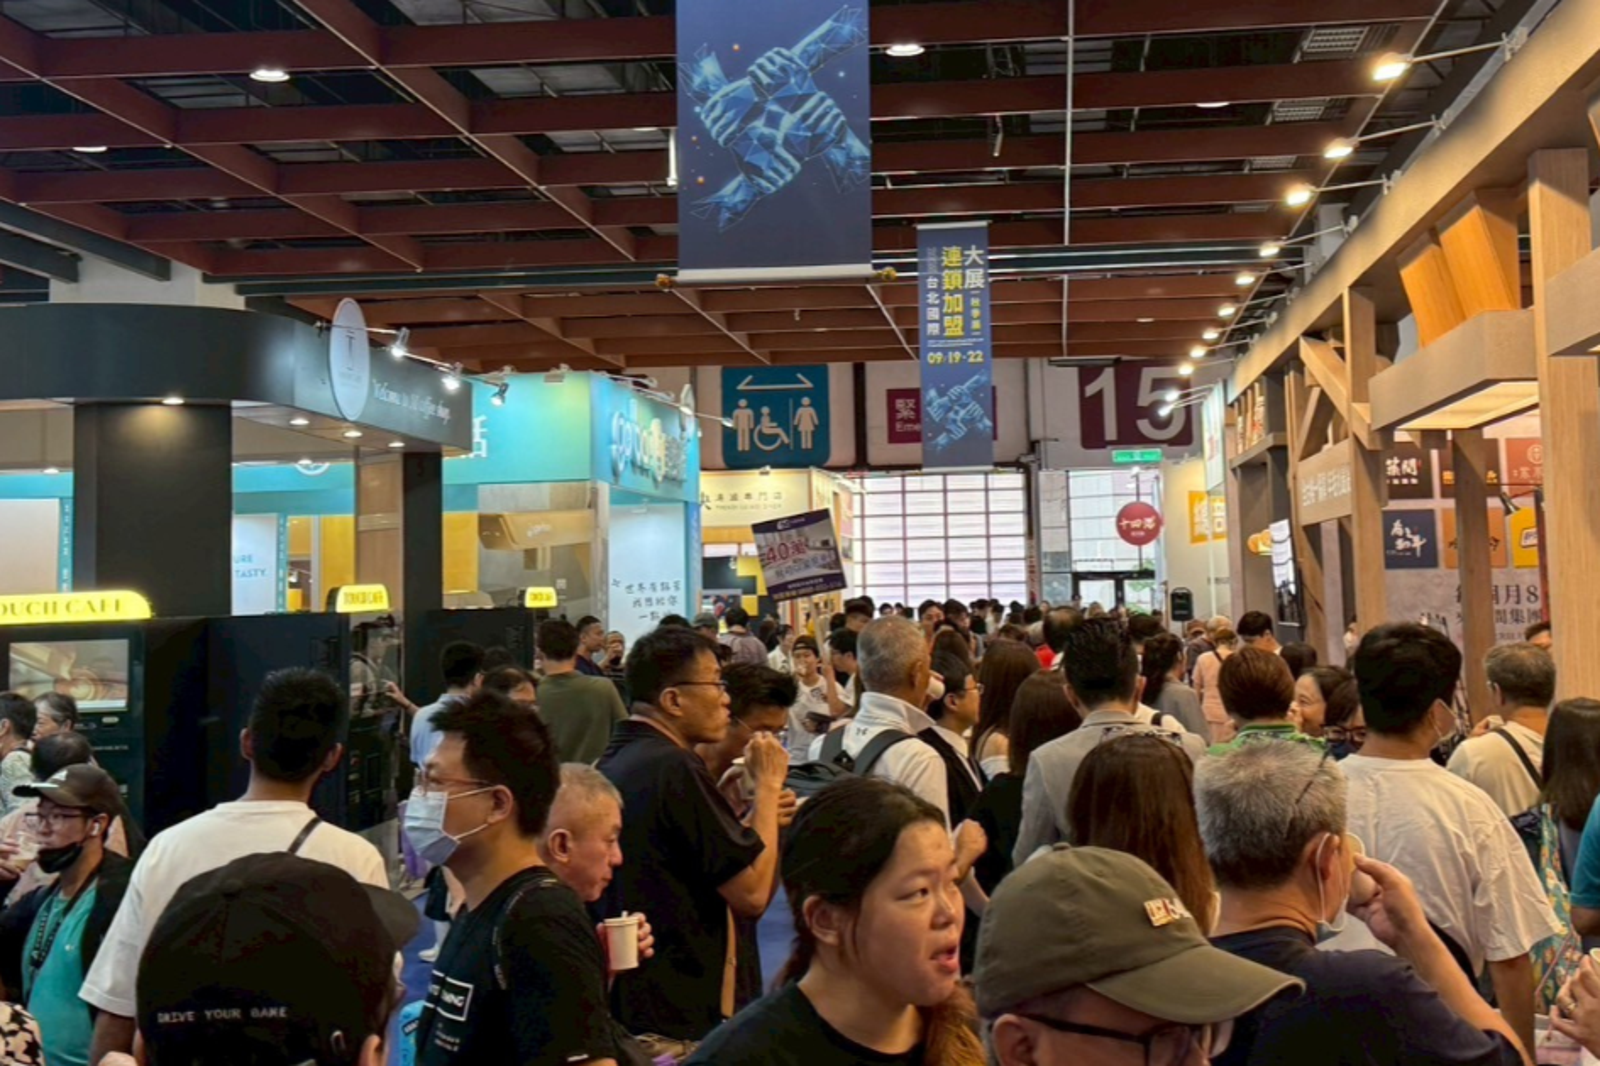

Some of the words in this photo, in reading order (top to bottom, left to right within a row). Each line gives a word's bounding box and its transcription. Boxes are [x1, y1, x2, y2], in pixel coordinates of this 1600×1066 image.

[942, 246, 965, 337] 連鎖加盟
[963, 245, 985, 288] 大展
[1084, 366, 1186, 441] 15
[205, 1008, 242, 1021] YOUR
